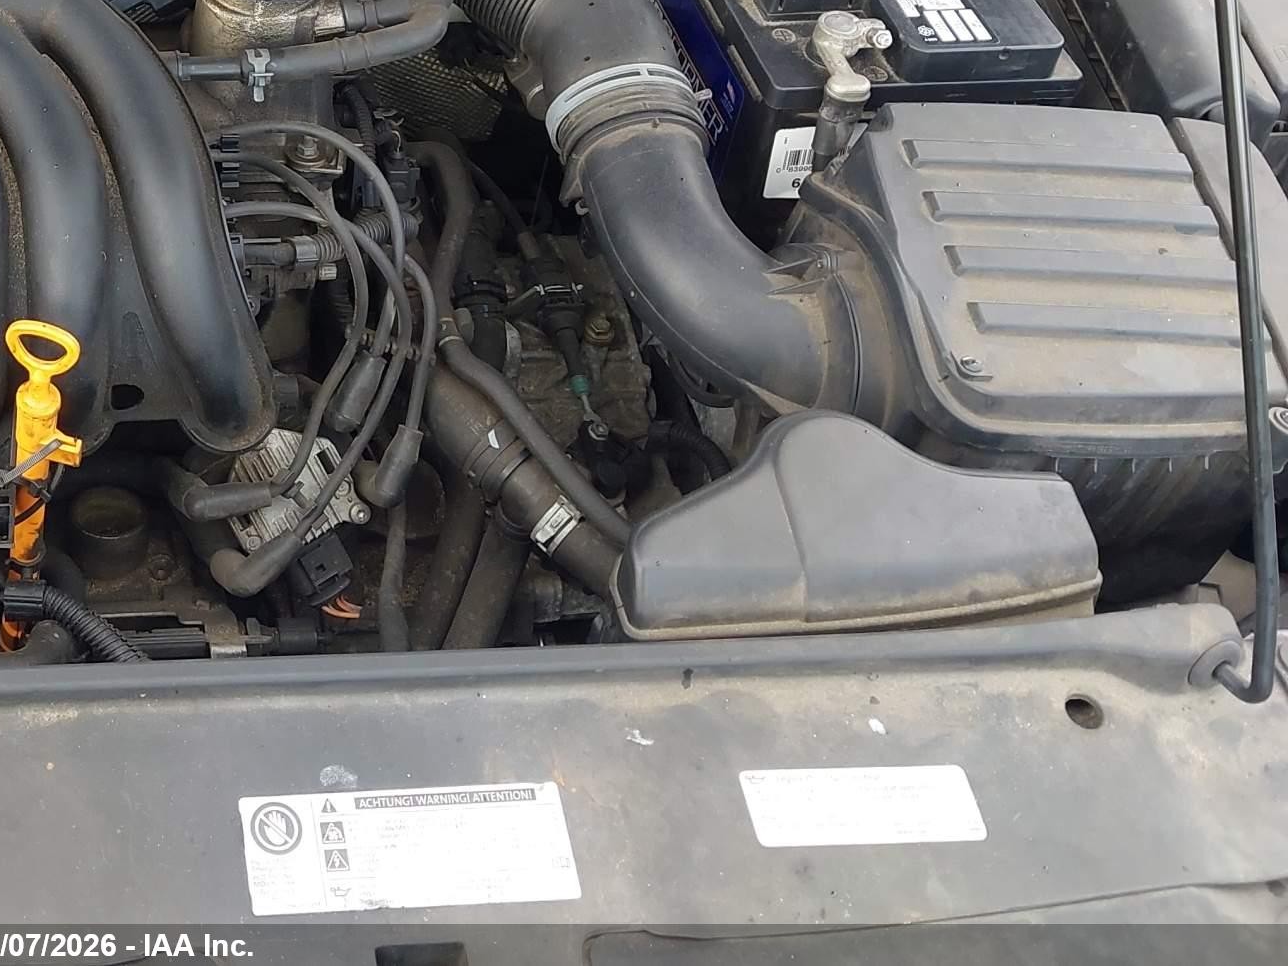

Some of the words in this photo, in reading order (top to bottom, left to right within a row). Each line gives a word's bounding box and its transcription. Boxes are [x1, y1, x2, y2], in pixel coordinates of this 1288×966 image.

[358, 796, 413, 809] ACHTUNG!
[415, 793, 470, 807] WARNING!
[472, 789, 532, 803] ATTENTION!
